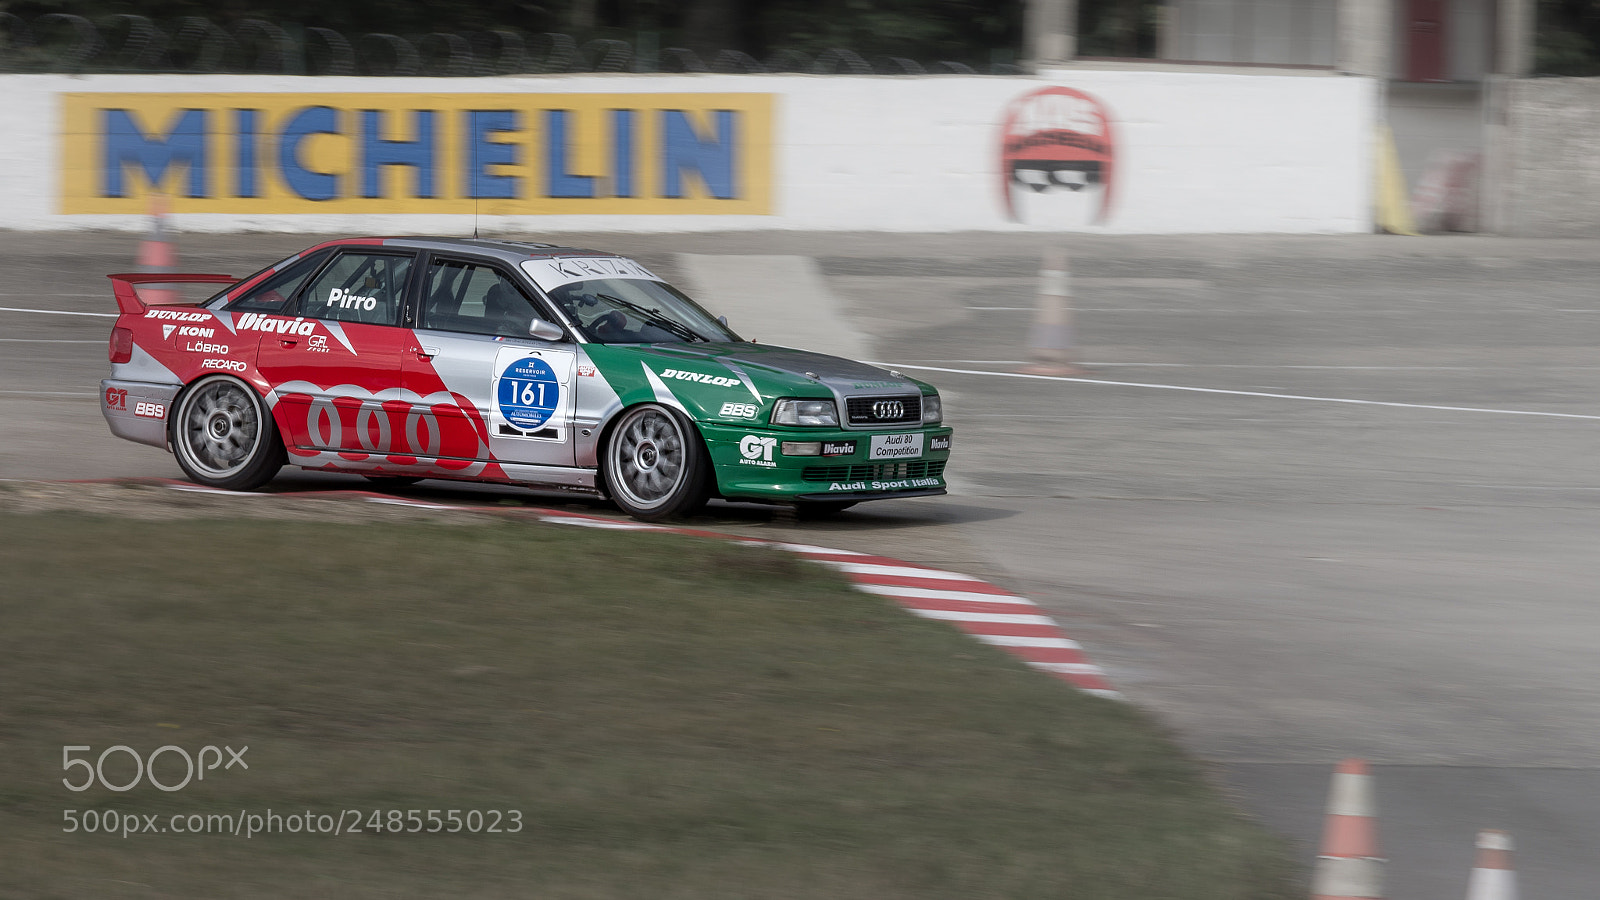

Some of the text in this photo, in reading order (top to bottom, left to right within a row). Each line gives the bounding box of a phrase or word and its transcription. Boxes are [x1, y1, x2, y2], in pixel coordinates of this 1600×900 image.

[99, 105, 743, 200] MICHELIN
[327, 288, 377, 311] Pirro
[144, 309, 212, 322] DUNLOP
[236, 312, 316, 336] Diavia
[179, 326, 215, 338] KONI
[186, 340, 229, 354] LÖBRO
[201, 358, 247, 372] RECARO
[515, 367, 546, 376] RESERVOIR
[660, 368, 741, 388] DUNLOP
[106, 387, 128, 407] GT
[511, 380, 545, 406] 161
[135, 402, 165, 418] BBS
[719, 403, 757, 418] BBS
[885, 434, 913, 445] Audi 80
[930, 437, 949, 449] Diavia
[740, 435, 777, 461] GT
[824, 442, 854, 455] Diavia
[876, 446, 919, 458] Competition
[739, 458, 756, 466] AUTO
[829, 477, 940, 490] Audi Sport Italia
